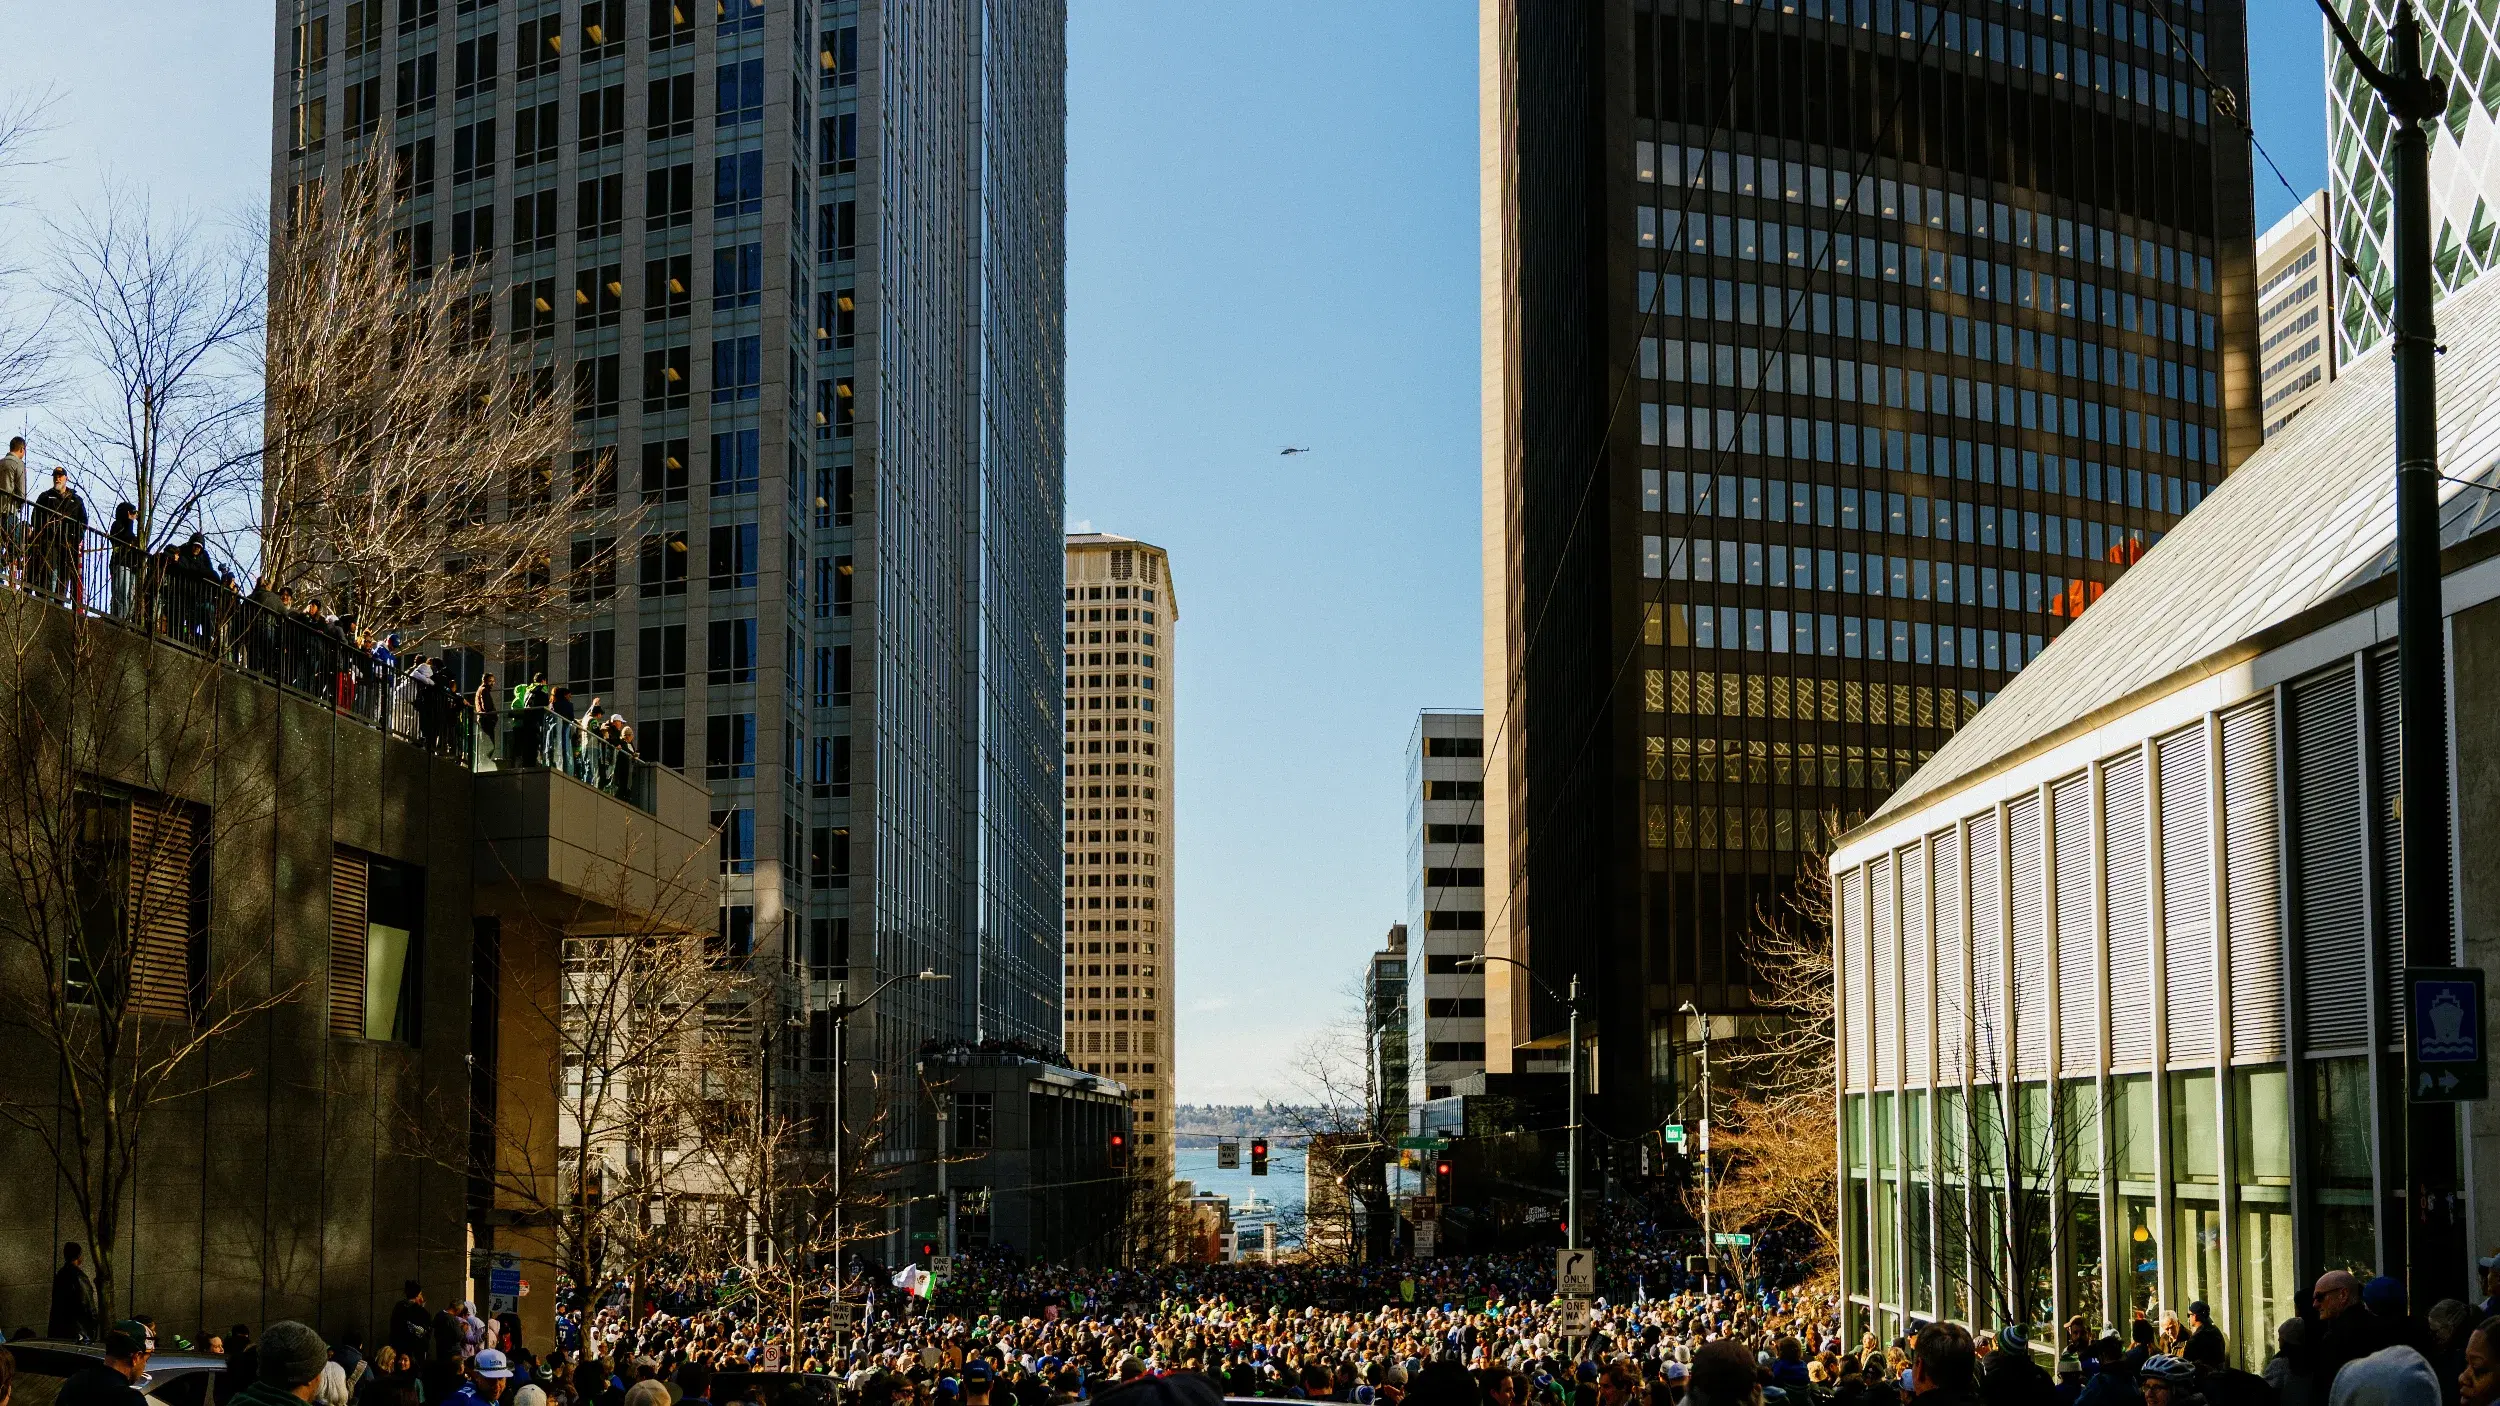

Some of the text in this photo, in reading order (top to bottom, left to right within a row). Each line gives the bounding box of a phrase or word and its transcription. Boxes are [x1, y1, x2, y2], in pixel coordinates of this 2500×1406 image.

[1563, 1275, 1588, 1284] ONLY
[1566, 1302, 1586, 1310] ONE
[1566, 1312, 1586, 1320] WAY
